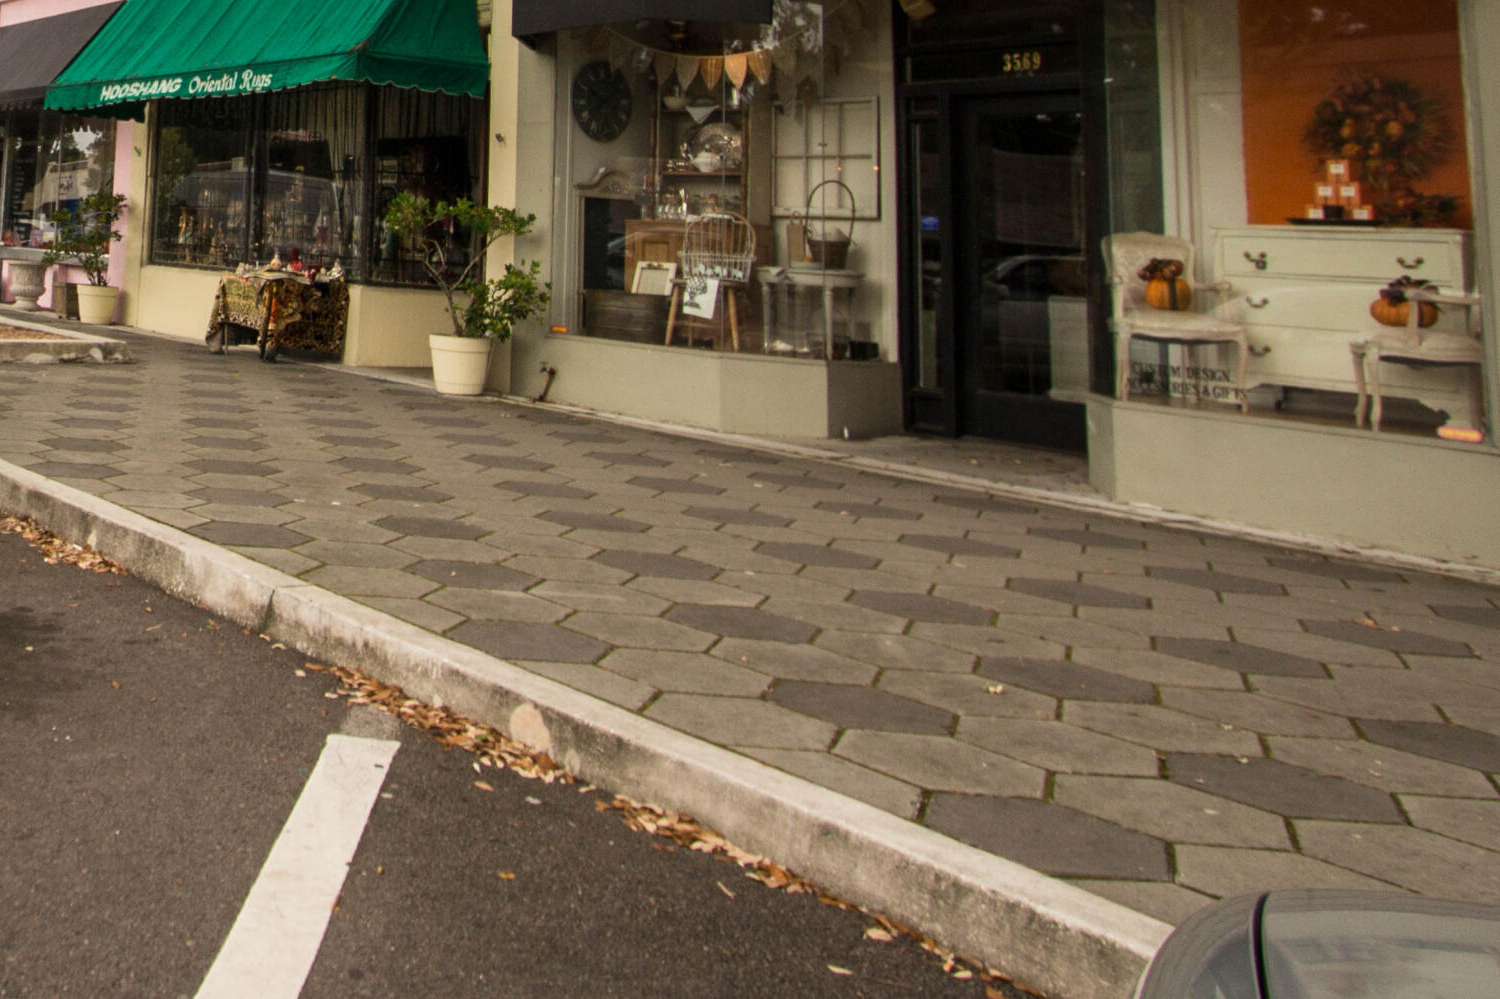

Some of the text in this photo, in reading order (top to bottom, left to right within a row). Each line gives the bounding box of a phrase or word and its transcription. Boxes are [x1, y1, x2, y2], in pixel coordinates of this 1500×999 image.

[1003, 51, 1041, 71] 3569
[100, 69, 273, 101] HOOSHANG Oriental Rugs
[1132, 361, 1230, 382] CUSTM DESIGN
